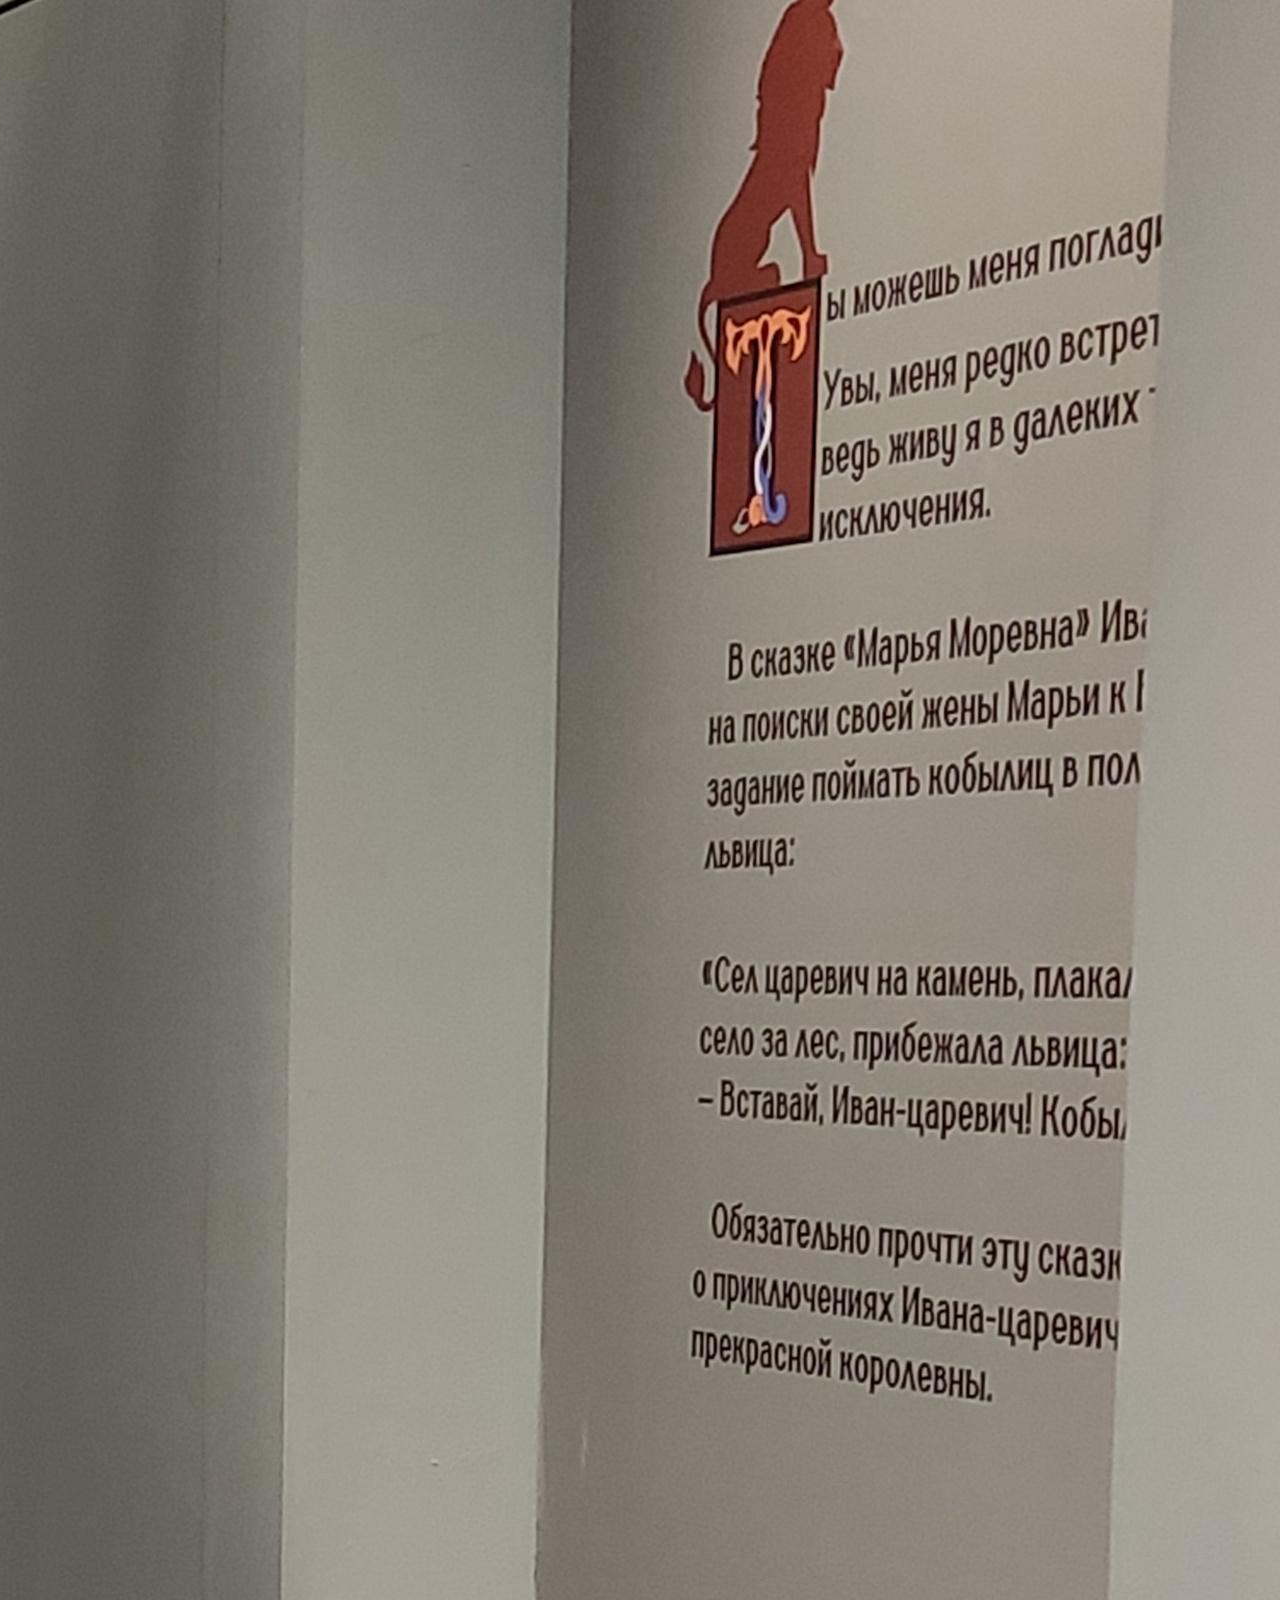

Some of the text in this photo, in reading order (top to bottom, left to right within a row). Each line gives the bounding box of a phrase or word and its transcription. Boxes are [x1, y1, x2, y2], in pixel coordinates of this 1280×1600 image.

[852, 263, 961, 318] можешь
[967, 242, 1041, 291] меня
[822, 367, 882, 412] Увы,
[888, 354, 958, 398] меня
[963, 335, 1051, 395] редко
[820, 388, 1142, 483] ведь живу я в далеких
[818, 486, 992, 543] исключения.
[727, 607, 1091, 682] В сказке «Марья Моревна»
[707, 678, 1127, 746] на поиски своей жены Марьи к
[706, 772, 806, 817] задание
[811, 758, 921, 803] поймать
[927, 750, 1055, 799] кобылиц
[1061, 755, 1079, 789] в
[703, 836, 796, 877] львица:
[701, 955, 760, 995] «Сел
[764, 963, 870, 1005] царевич
[876, 964, 909, 997] на
[915, 965, 1025, 1002] камень,
[699, 1020, 1128, 1079] село за лес, прибежала львица:
[719, 1078, 1128, 1142] Вставай, Иван-царевич! Кобы
[710, 1201, 872, 1256] Обязательно
[877, 1226, 975, 1269] прочти
[980, 1236, 1031, 1284] эту
[692, 1269, 707, 1299] о
[712, 1271, 896, 1324] приключениях
[690, 1329, 993, 1403] прекрасной королевны.
